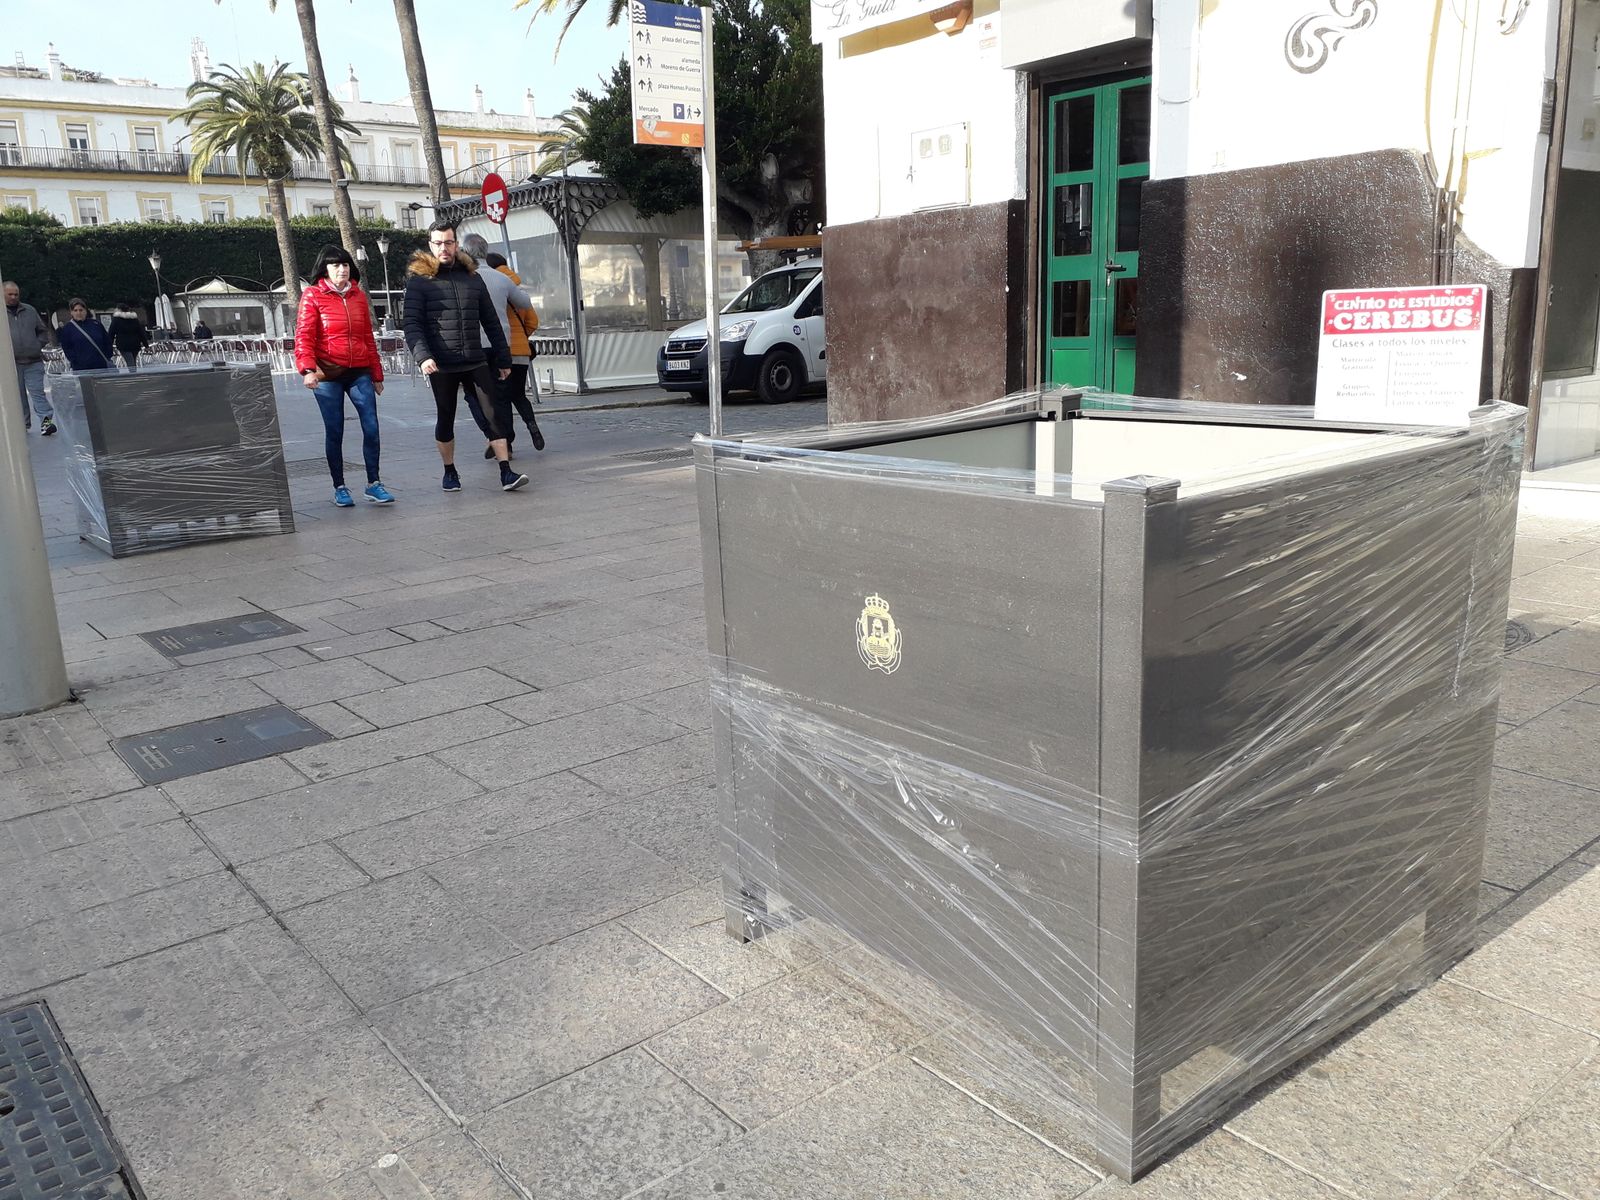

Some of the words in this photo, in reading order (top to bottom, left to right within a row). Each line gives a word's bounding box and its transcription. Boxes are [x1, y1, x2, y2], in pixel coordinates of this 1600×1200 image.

[661, 35, 675, 43] plaza
[638, 105, 659, 113] Mercado
[1334, 296, 1386, 310] CENTRO
[1388, 298, 1405, 309] DE
[1408, 295, 1474, 309] ESTUDIOS
[1333, 308, 1473, 330] CEREBUS
[1332, 338, 1365, 348] Clases
[1378, 337, 1407, 347] todos
[1411, 337, 1426, 346] los
